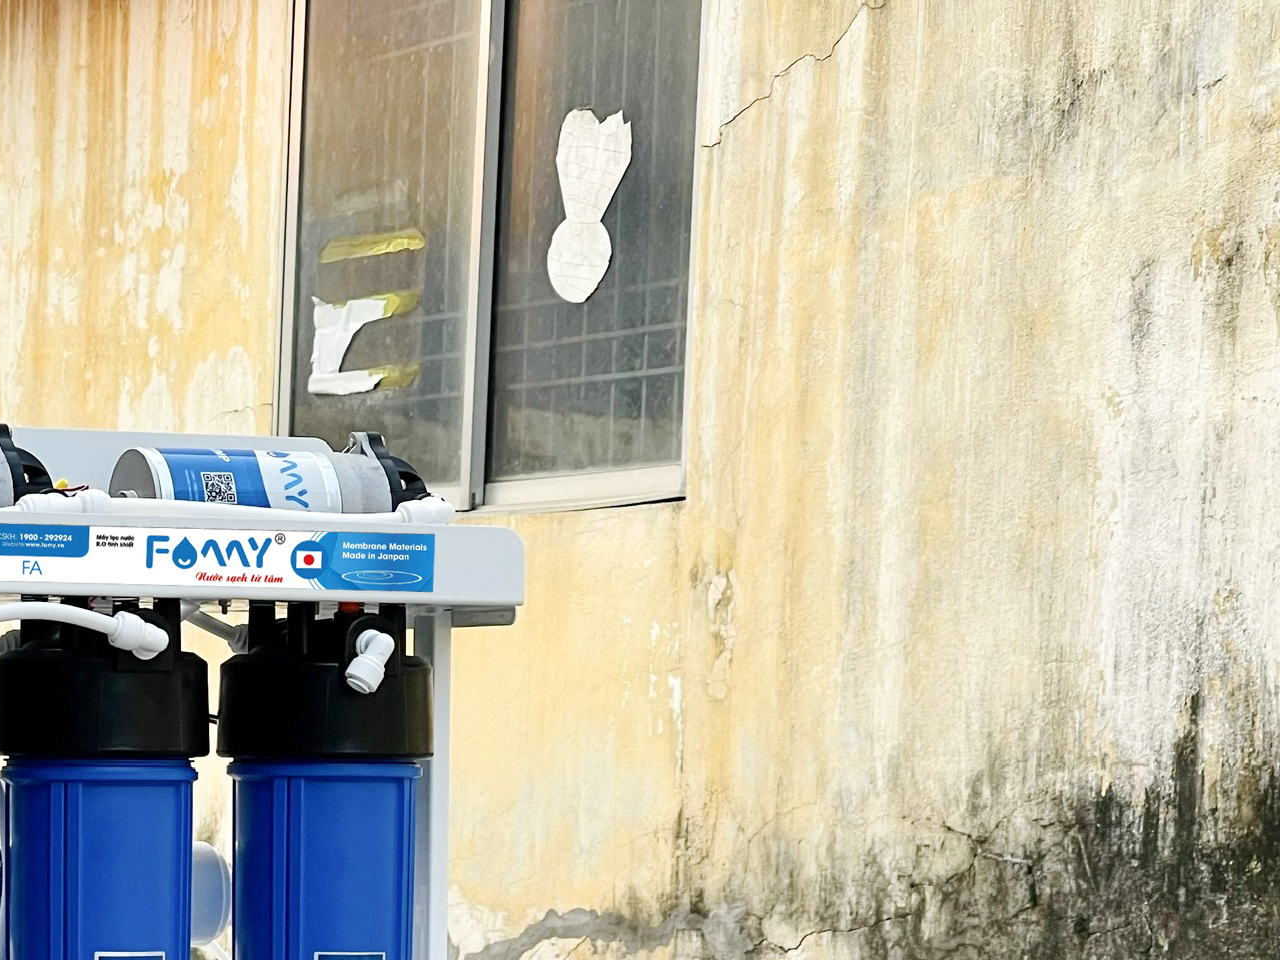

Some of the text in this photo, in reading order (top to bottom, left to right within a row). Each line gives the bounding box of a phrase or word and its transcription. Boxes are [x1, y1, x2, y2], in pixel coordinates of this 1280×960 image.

[20, 533, 38, 541] 1900
[44, 533, 72, 542] 292924
[342, 542, 427, 551] Membrane Materials
[342, 551, 410, 561] Made in Janpan
[22, 560, 43, 575] FA
[195, 571, 284, 583] Nước sạch từ tâm
